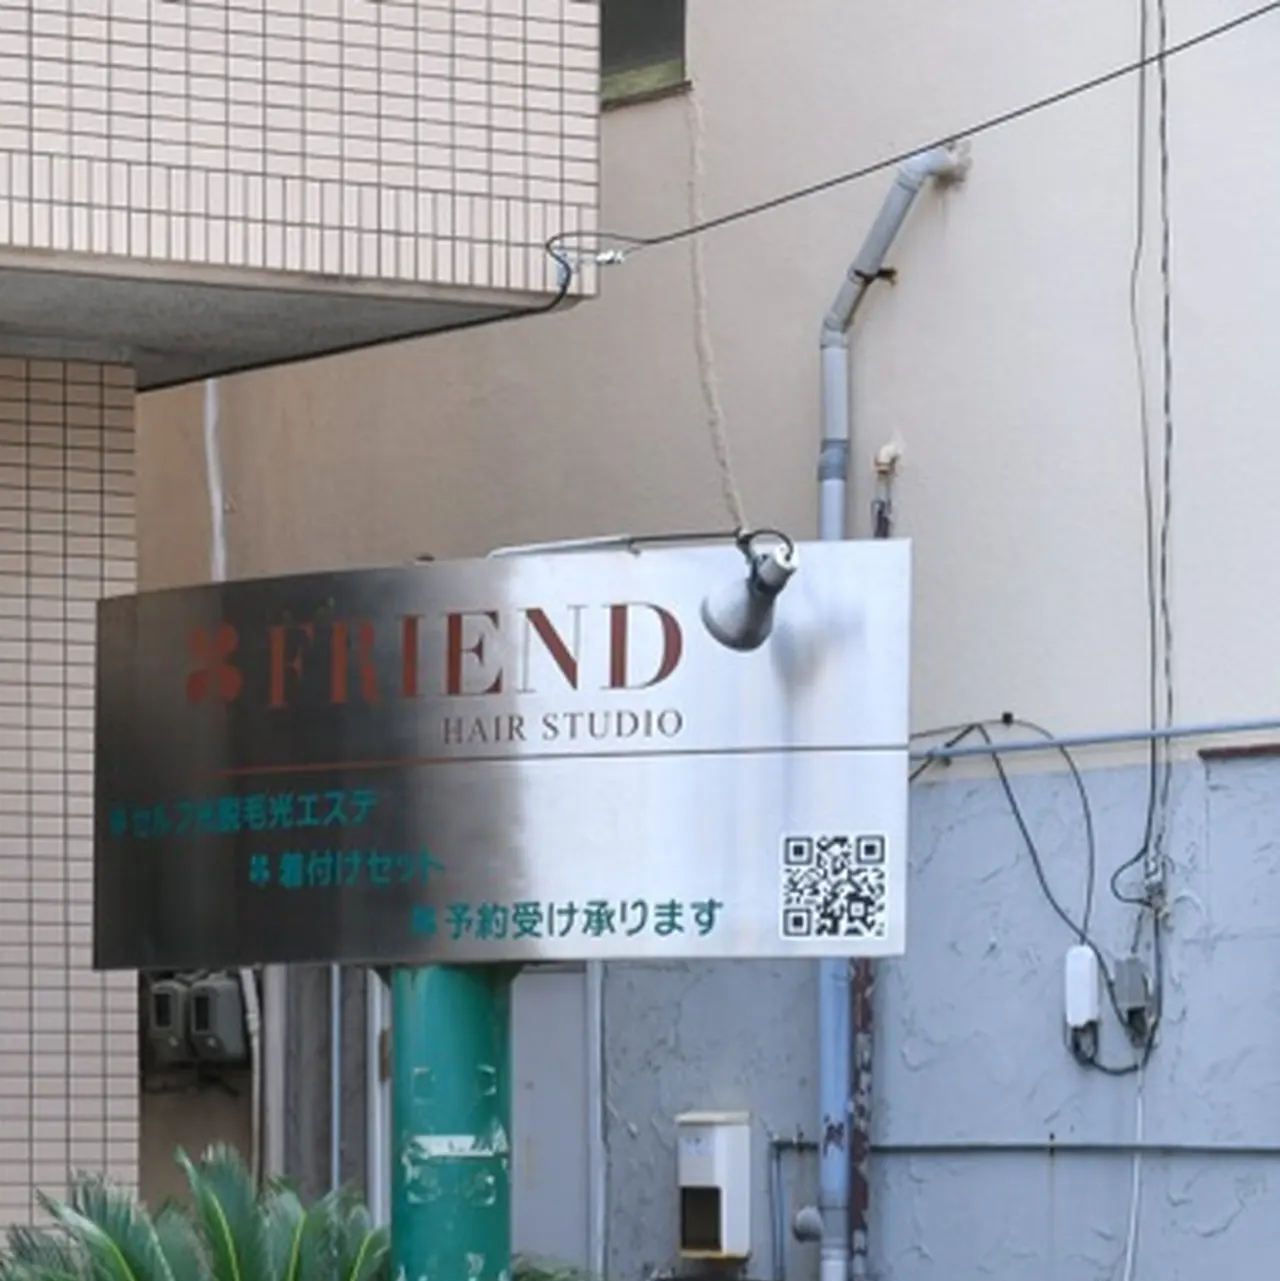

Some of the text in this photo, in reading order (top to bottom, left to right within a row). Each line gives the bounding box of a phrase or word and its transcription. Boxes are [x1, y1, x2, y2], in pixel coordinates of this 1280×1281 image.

[266, 602, 684, 710] FRIEND
[443, 707, 684, 745] HAIR STUDIO
[444, 897, 724, 941] 予約受け承ります
